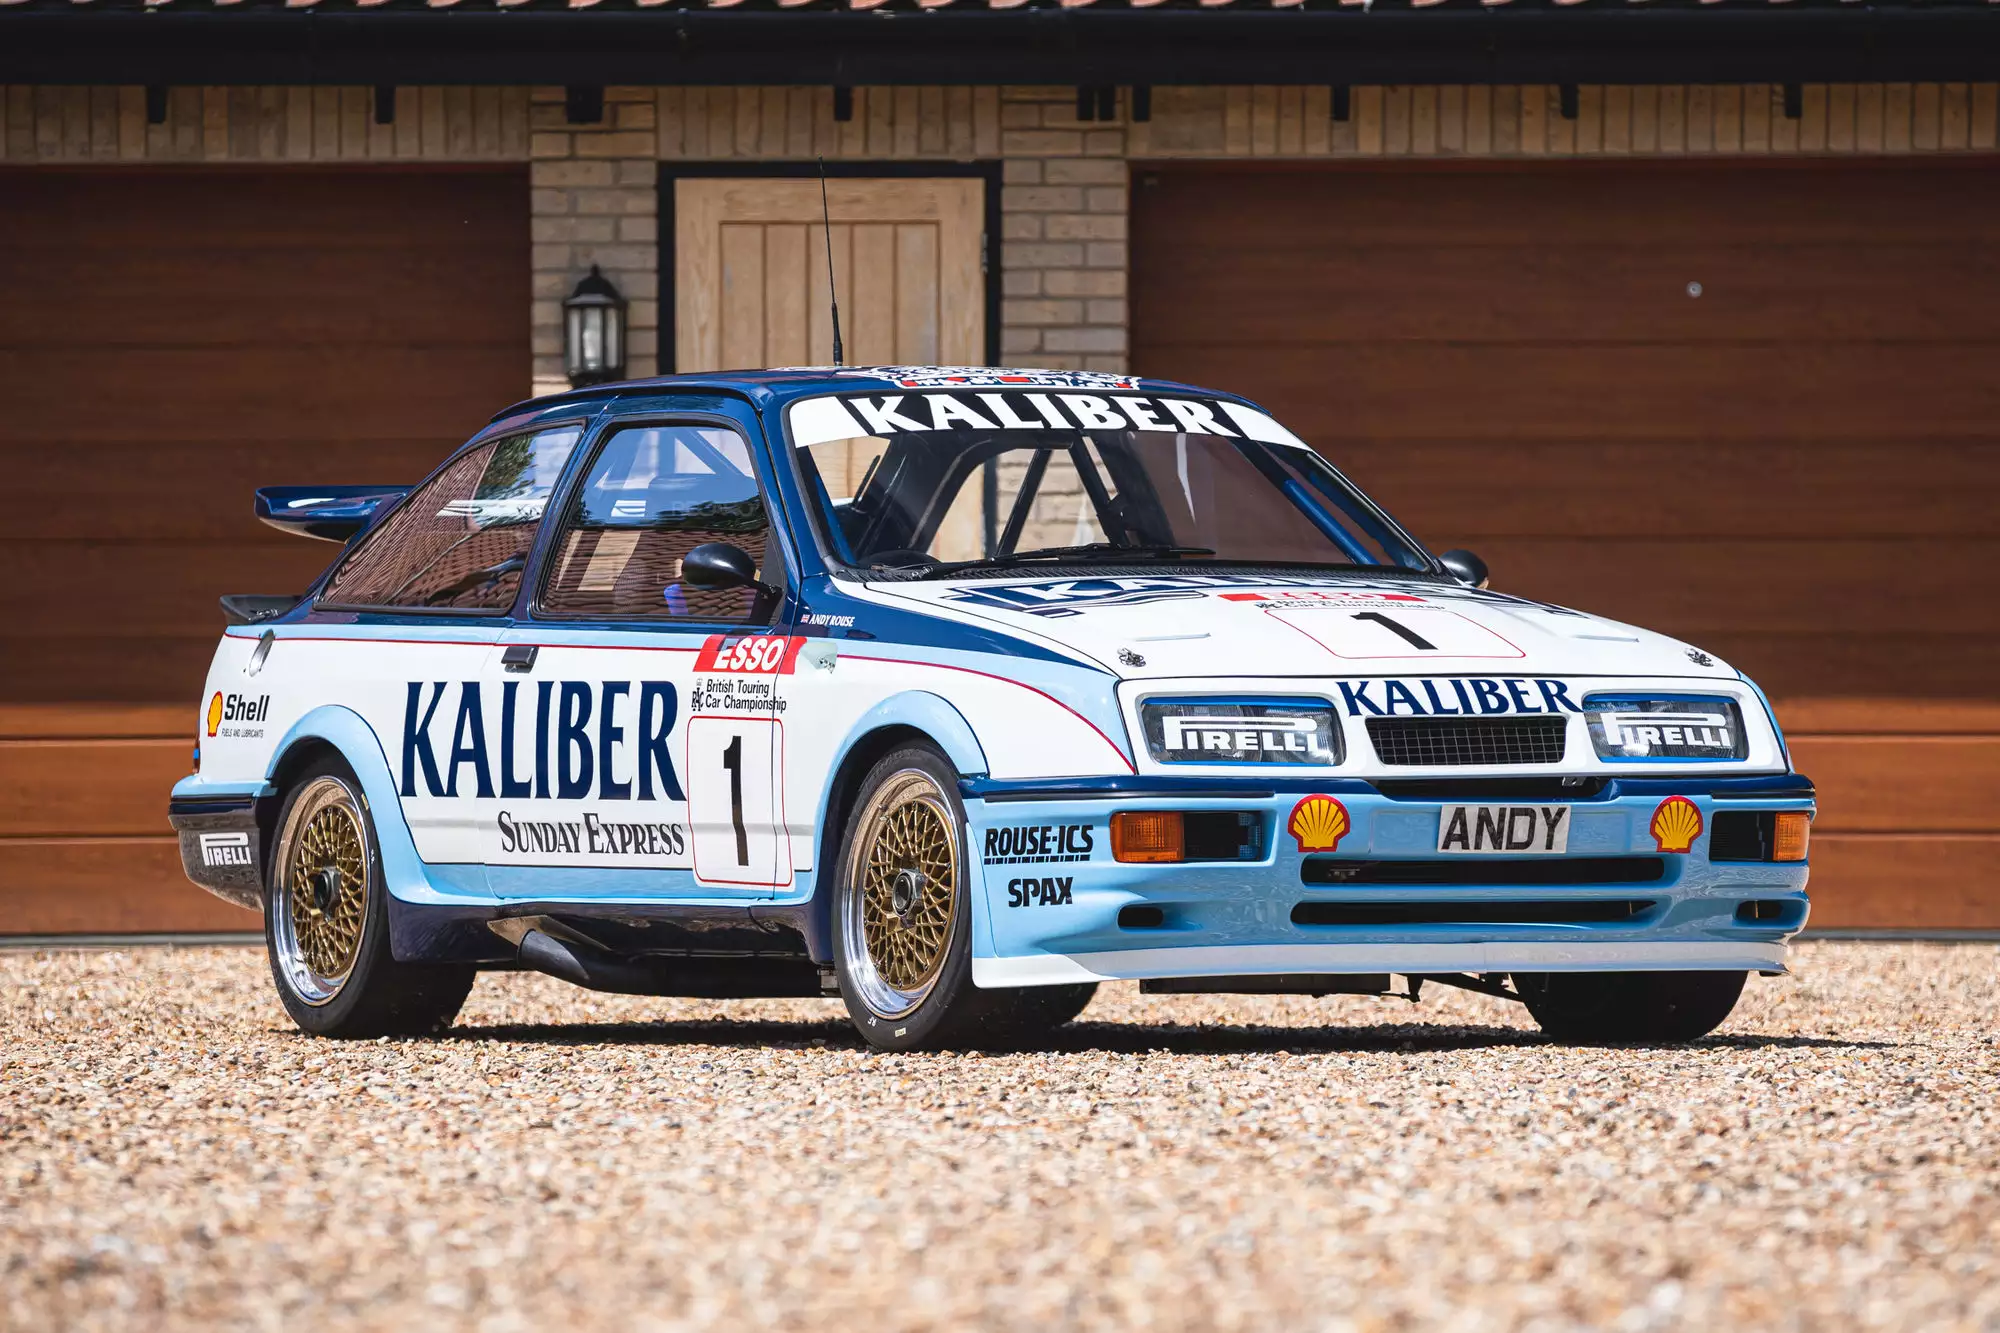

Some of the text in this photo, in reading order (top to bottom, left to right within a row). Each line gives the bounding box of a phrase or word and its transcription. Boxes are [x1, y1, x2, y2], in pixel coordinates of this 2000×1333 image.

[848, 393, 1242, 438] KALIBER
[809, 614, 855, 627] ANDY ROUSE
[1350, 612, 1438, 651] 1
[713, 637, 785, 672] ESSO
[705, 693, 787, 714] Car Championship
[706, 678, 769, 698] British Touring
[1336, 679, 1585, 716] KALIBER
[224, 694, 270, 721] Shell
[400, 680, 688, 801] KALIBER
[1162, 716, 1318, 751] PIRELLI
[1600, 712, 1731, 747] PIRELLI
[723, 735, 749, 866] 1
[498, 811, 685, 855] SUNDAY EXPRESS
[984, 825, 1094, 857] ROUSE-ICS
[1442, 806, 1567, 851] ANDY
[200, 832, 252, 866] PIRELLI
[1008, 876, 1073, 908] SPAX
